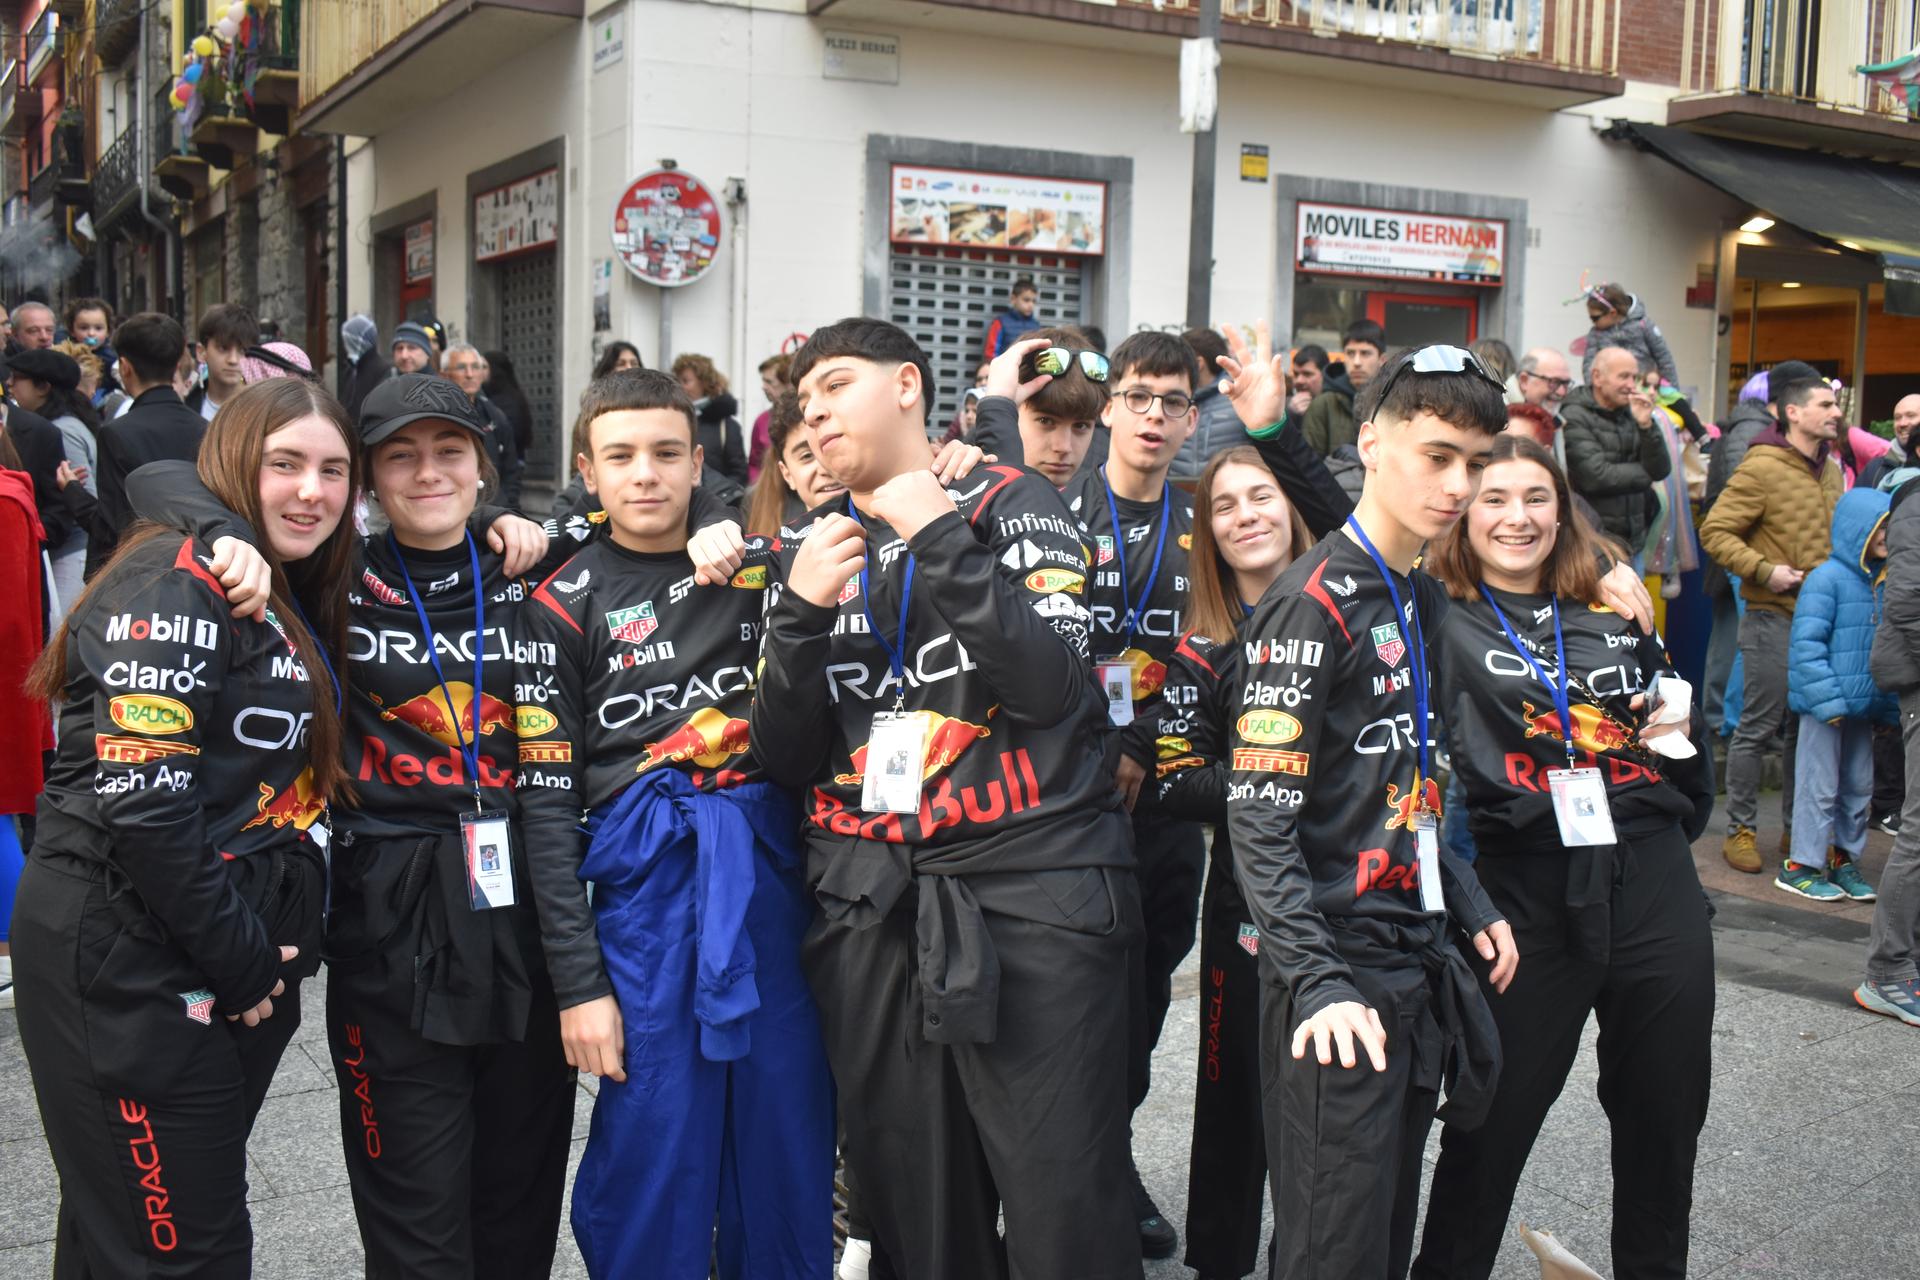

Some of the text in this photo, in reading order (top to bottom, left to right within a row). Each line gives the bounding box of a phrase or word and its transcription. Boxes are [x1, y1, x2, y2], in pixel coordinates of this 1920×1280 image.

[1306, 212, 1400, 241] MOVILES
[610, 604, 651, 626] TAG
[1088, 605, 1184, 637] RACL
[106, 613, 218, 651] Mobil 1
[613, 619, 657, 641] HEUER
[1374, 625, 1398, 643] TAG
[347, 625, 514, 664] ORACL
[514, 640, 537, 664] bil
[608, 640, 675, 673] Mobil 1
[1246, 639, 1299, 665] Mobil
[1302, 640, 1324, 667] 1
[1378, 641, 1403, 664] HEUER
[103, 656, 202, 694] Claro
[825, 633, 977, 703] RACL
[514, 681, 552, 703] aro
[1243, 677, 1305, 708] Claro
[126, 703, 187, 726] RAUCH
[358, 735, 464, 787] Red
[94, 768, 147, 795] Cash
[919, 747, 1041, 839] Bull
[1259, 781, 1304, 808] App
[1240, 936, 1258, 951] HEU
[1243, 926, 1260, 936] TA
[1206, 965, 1224, 1082] ORACLE
[119, 1098, 178, 1252] ORACLE
